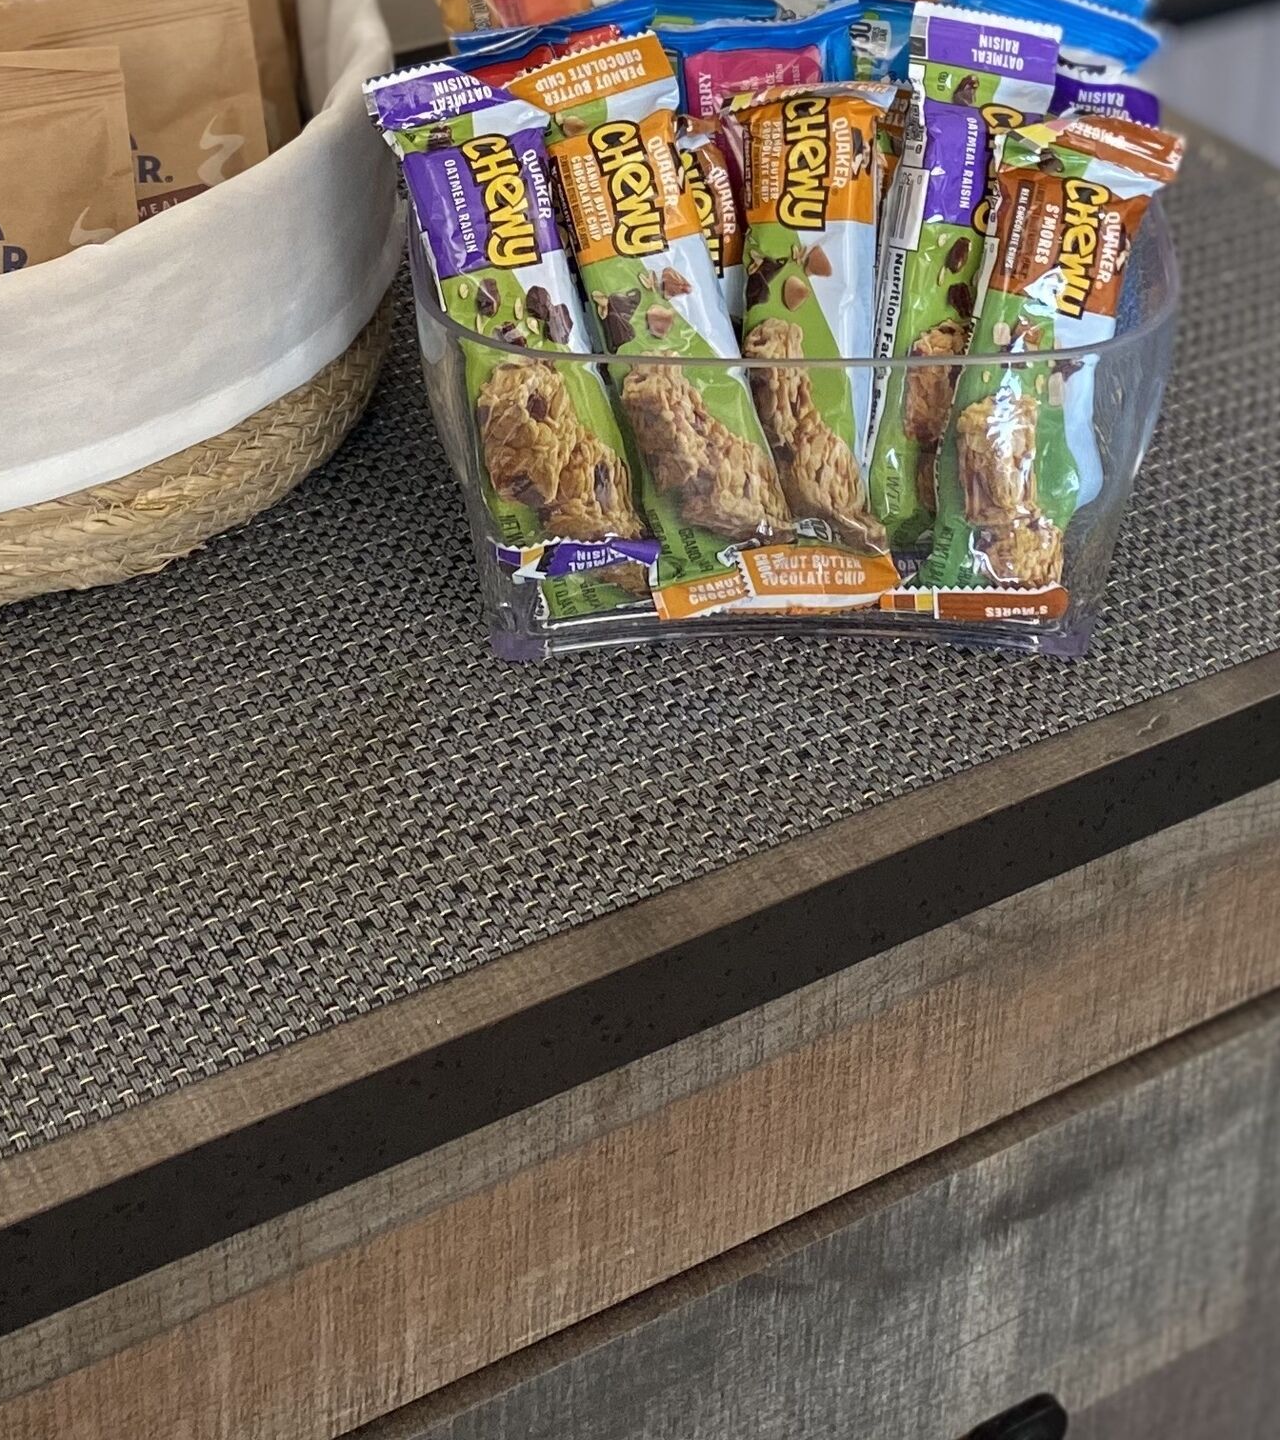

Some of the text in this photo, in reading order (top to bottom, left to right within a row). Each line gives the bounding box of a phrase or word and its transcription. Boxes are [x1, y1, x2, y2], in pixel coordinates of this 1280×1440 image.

[971, 48, 1024, 72] OATMEAL
[979, 34, 1020, 54] RAISIN
[534, 48, 643, 94] CHOCOLATE CHIP
[544, 63, 646, 107] PEANUT BUTTER
[429, 85, 493, 112] OATMEAL
[1078, 88, 1125, 107] RAISIN
[647, 135, 681, 209] QUAKER
[761, 120, 773, 176] CHOCOLATE
[770, 121, 782, 200] PEANUT BUTTER
[830, 116, 853, 190] QUAKER
[959, 117, 979, 210] OATMEAL RAISIN
[444, 159, 478, 253] OATMEAL RAISIN
[521, 148, 552, 220] QUAKER
[571, 155, 594, 216] CHOCOLATE
[587, 217, 602, 241] CHIP
[583, 154, 613, 236] PEANUT BUTTER
[706, 166, 736, 235] QUAKER
[1010, 205, 1027, 246] CHOCOLATE
[1034, 203, 1060, 265] S'MORES
[1097, 211, 1121, 284] QUAKER
[884, 252, 904, 327] Nutrition
[568, 547, 626, 572] ATMEAL
[576, 549, 606, 561] ISIN
[812, 554, 862, 569] BUTTER
[834, 571, 866, 586] CHIP
[688, 576, 740, 592] PEANUT
[984, 604, 1049, 618] S'MORES
